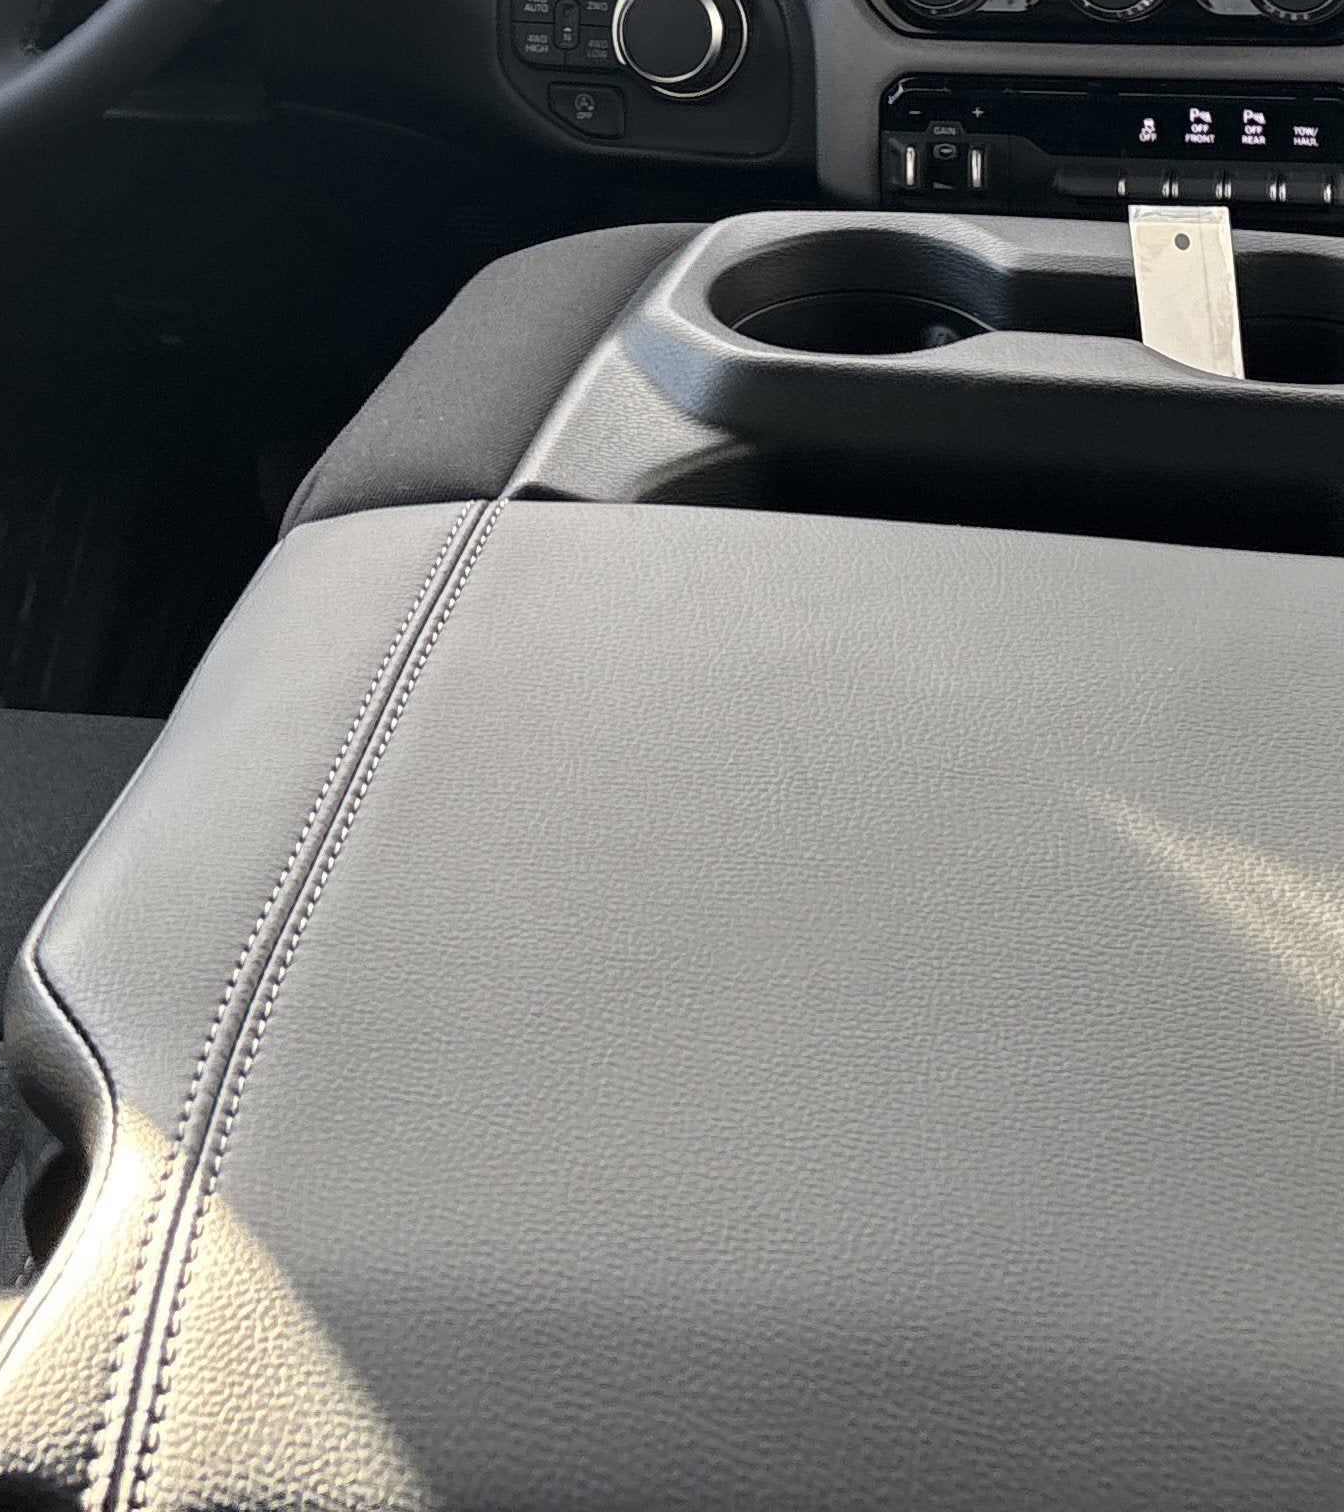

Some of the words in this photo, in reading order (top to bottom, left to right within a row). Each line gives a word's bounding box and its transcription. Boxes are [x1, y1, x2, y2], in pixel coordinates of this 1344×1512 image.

[524, 4, 549, 12] AUTO
[1191, 124, 1209, 133] OFF
[1245, 125, 1263, 134] OFF
[1185, 133, 1215, 144] FRONT
[1241, 135, 1266, 145] REAR
[1293, 137, 1319, 147] HAUL
